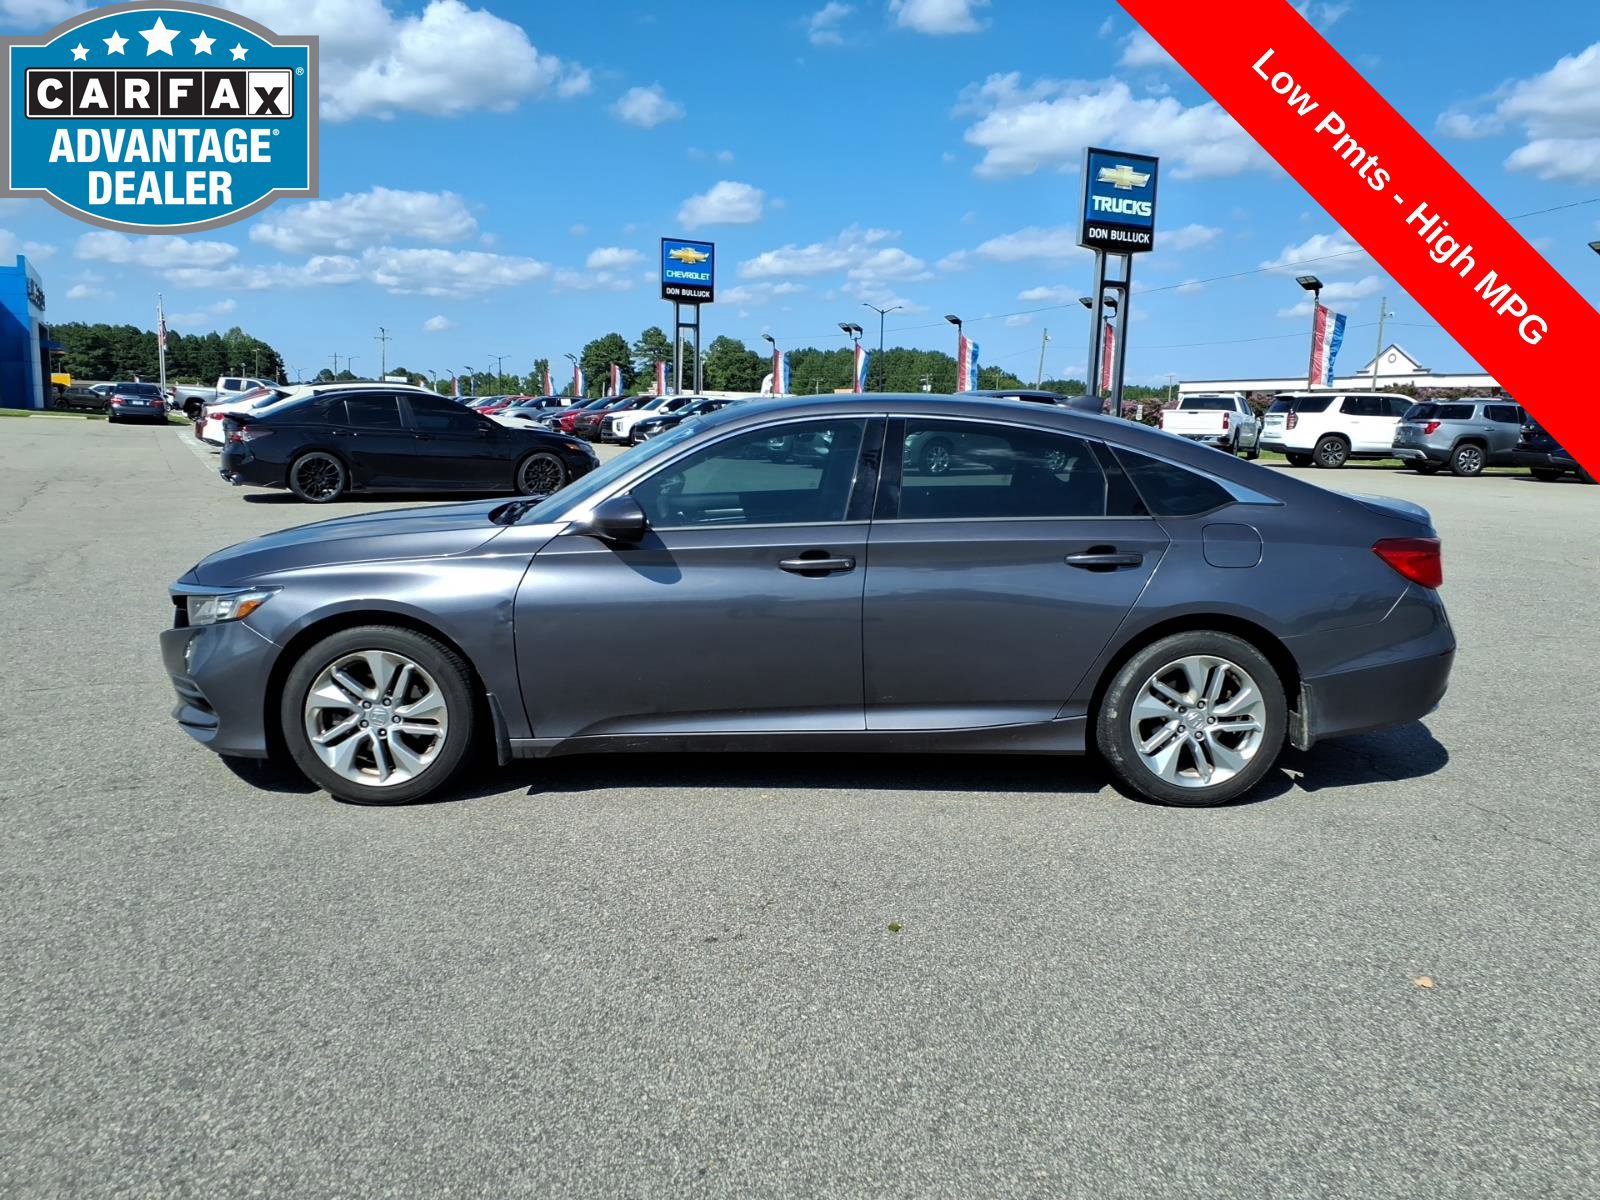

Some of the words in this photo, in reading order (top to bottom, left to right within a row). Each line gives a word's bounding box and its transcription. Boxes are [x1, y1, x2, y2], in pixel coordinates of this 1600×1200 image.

[1092, 195, 1151, 216] TRUCKS
[1089, 227, 1108, 239] DON
[1110, 230, 1150, 244] BULLUCK
[666, 270, 710, 280] CHEVROLET
[666, 287, 680, 295] DON
[681, 288, 710, 297] BULLUCK
